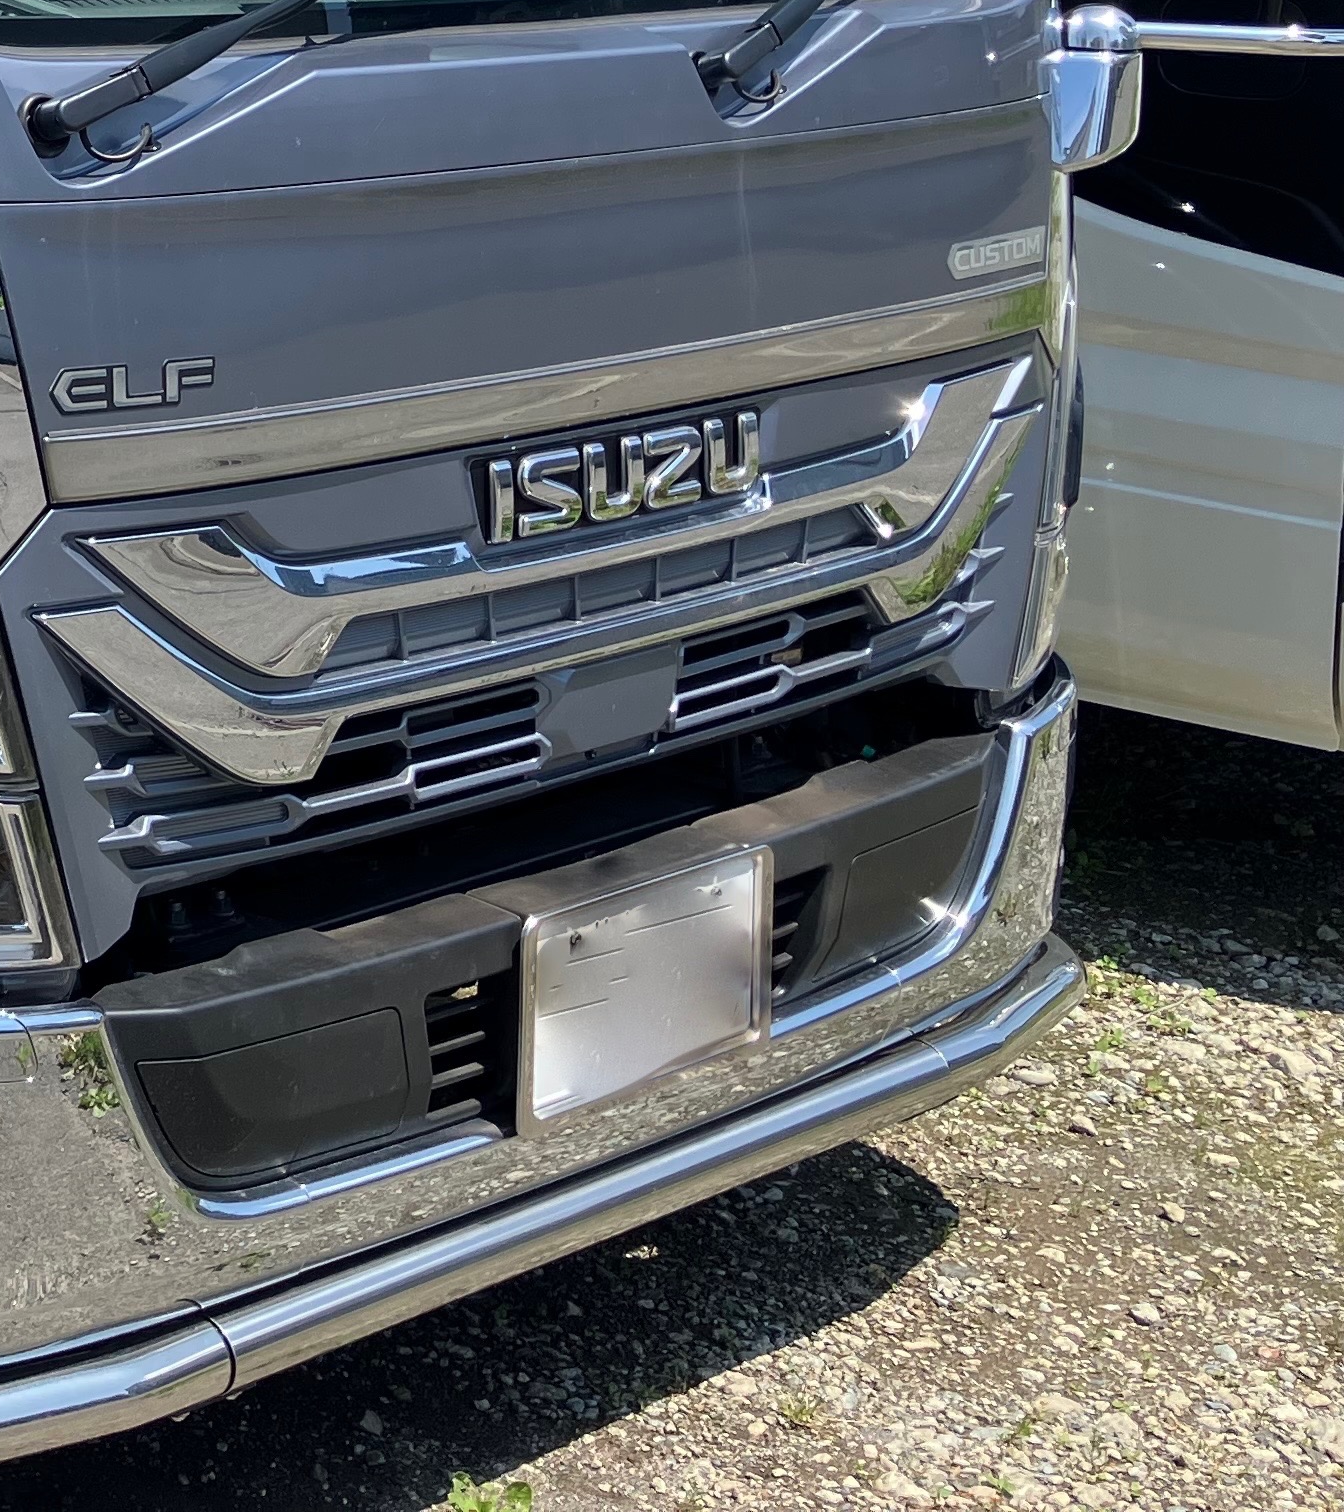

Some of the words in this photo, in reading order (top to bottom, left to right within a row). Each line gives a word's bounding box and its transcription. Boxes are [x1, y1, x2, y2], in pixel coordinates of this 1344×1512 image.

[953, 233, 1041, 271] CUSTOM
[52, 357, 214, 413] ELF
[488, 411, 761, 544] ISUZU
